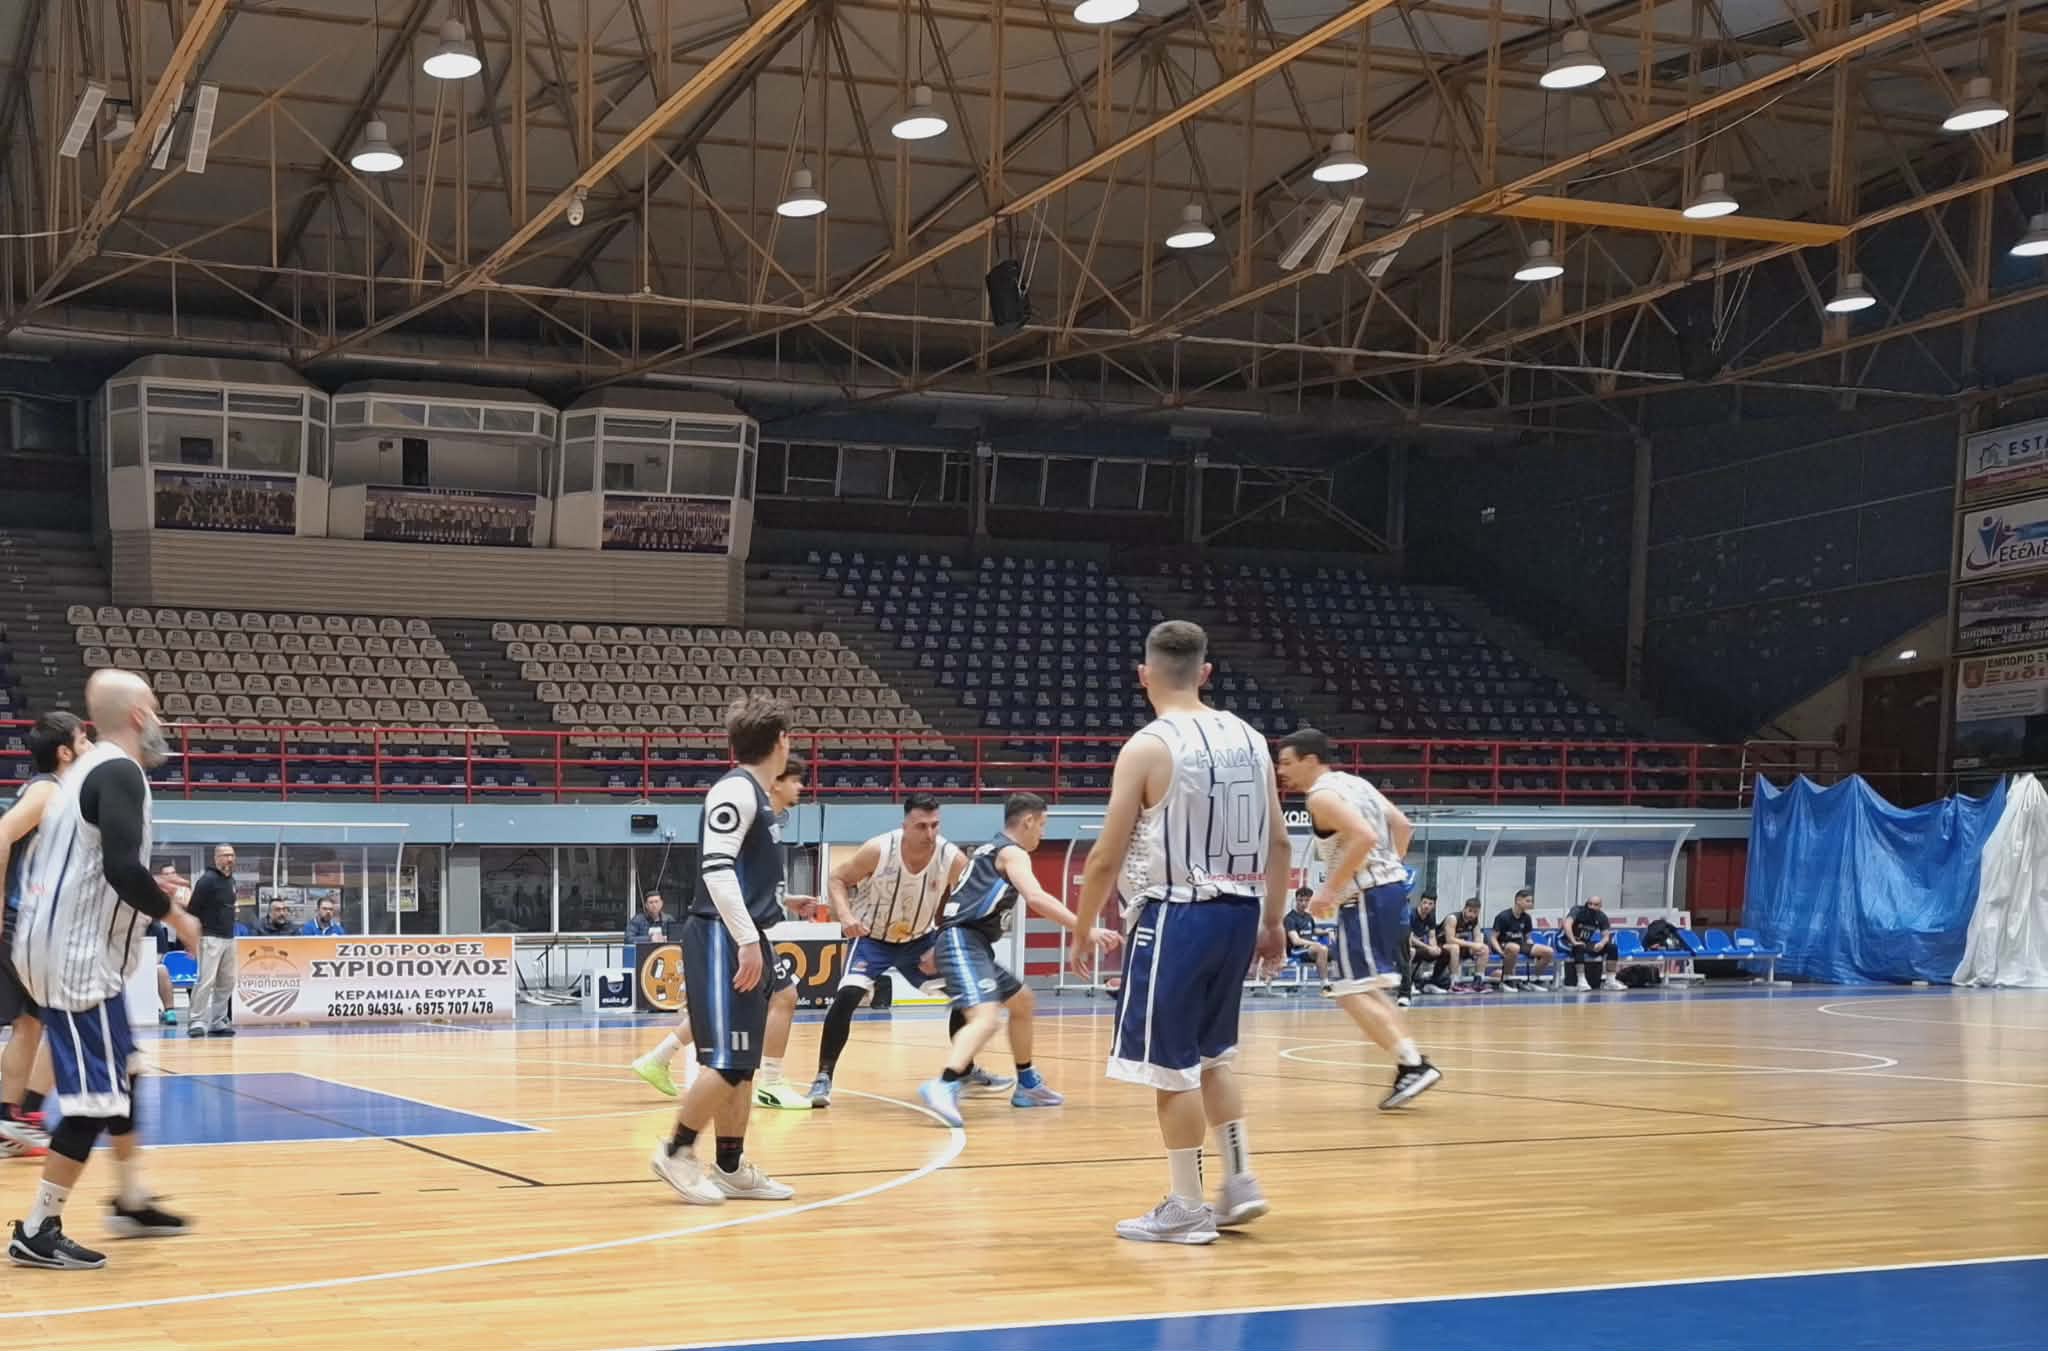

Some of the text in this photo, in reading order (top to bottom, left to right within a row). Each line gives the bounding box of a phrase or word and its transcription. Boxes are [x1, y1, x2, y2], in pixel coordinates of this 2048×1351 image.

[1208, 780, 1258, 857] 10
[338, 943, 483, 957] ΖΩΟΤΡΟΦΕΣ
[311, 959, 508, 978] ΣΥΡΙΟΠΟΥΛΟΣ
[335, 988, 487, 1001] ΚΕΡΑΜΙΔΙΑ ΕΦΥΡΑΣ
[328, 1003, 364, 1017] 26220
[367, 1003, 404, 1016] 94934
[415, 1002, 445, 1015] 6975
[447, 1001, 469, 1015] 707
[472, 1001, 494, 1014] 478
